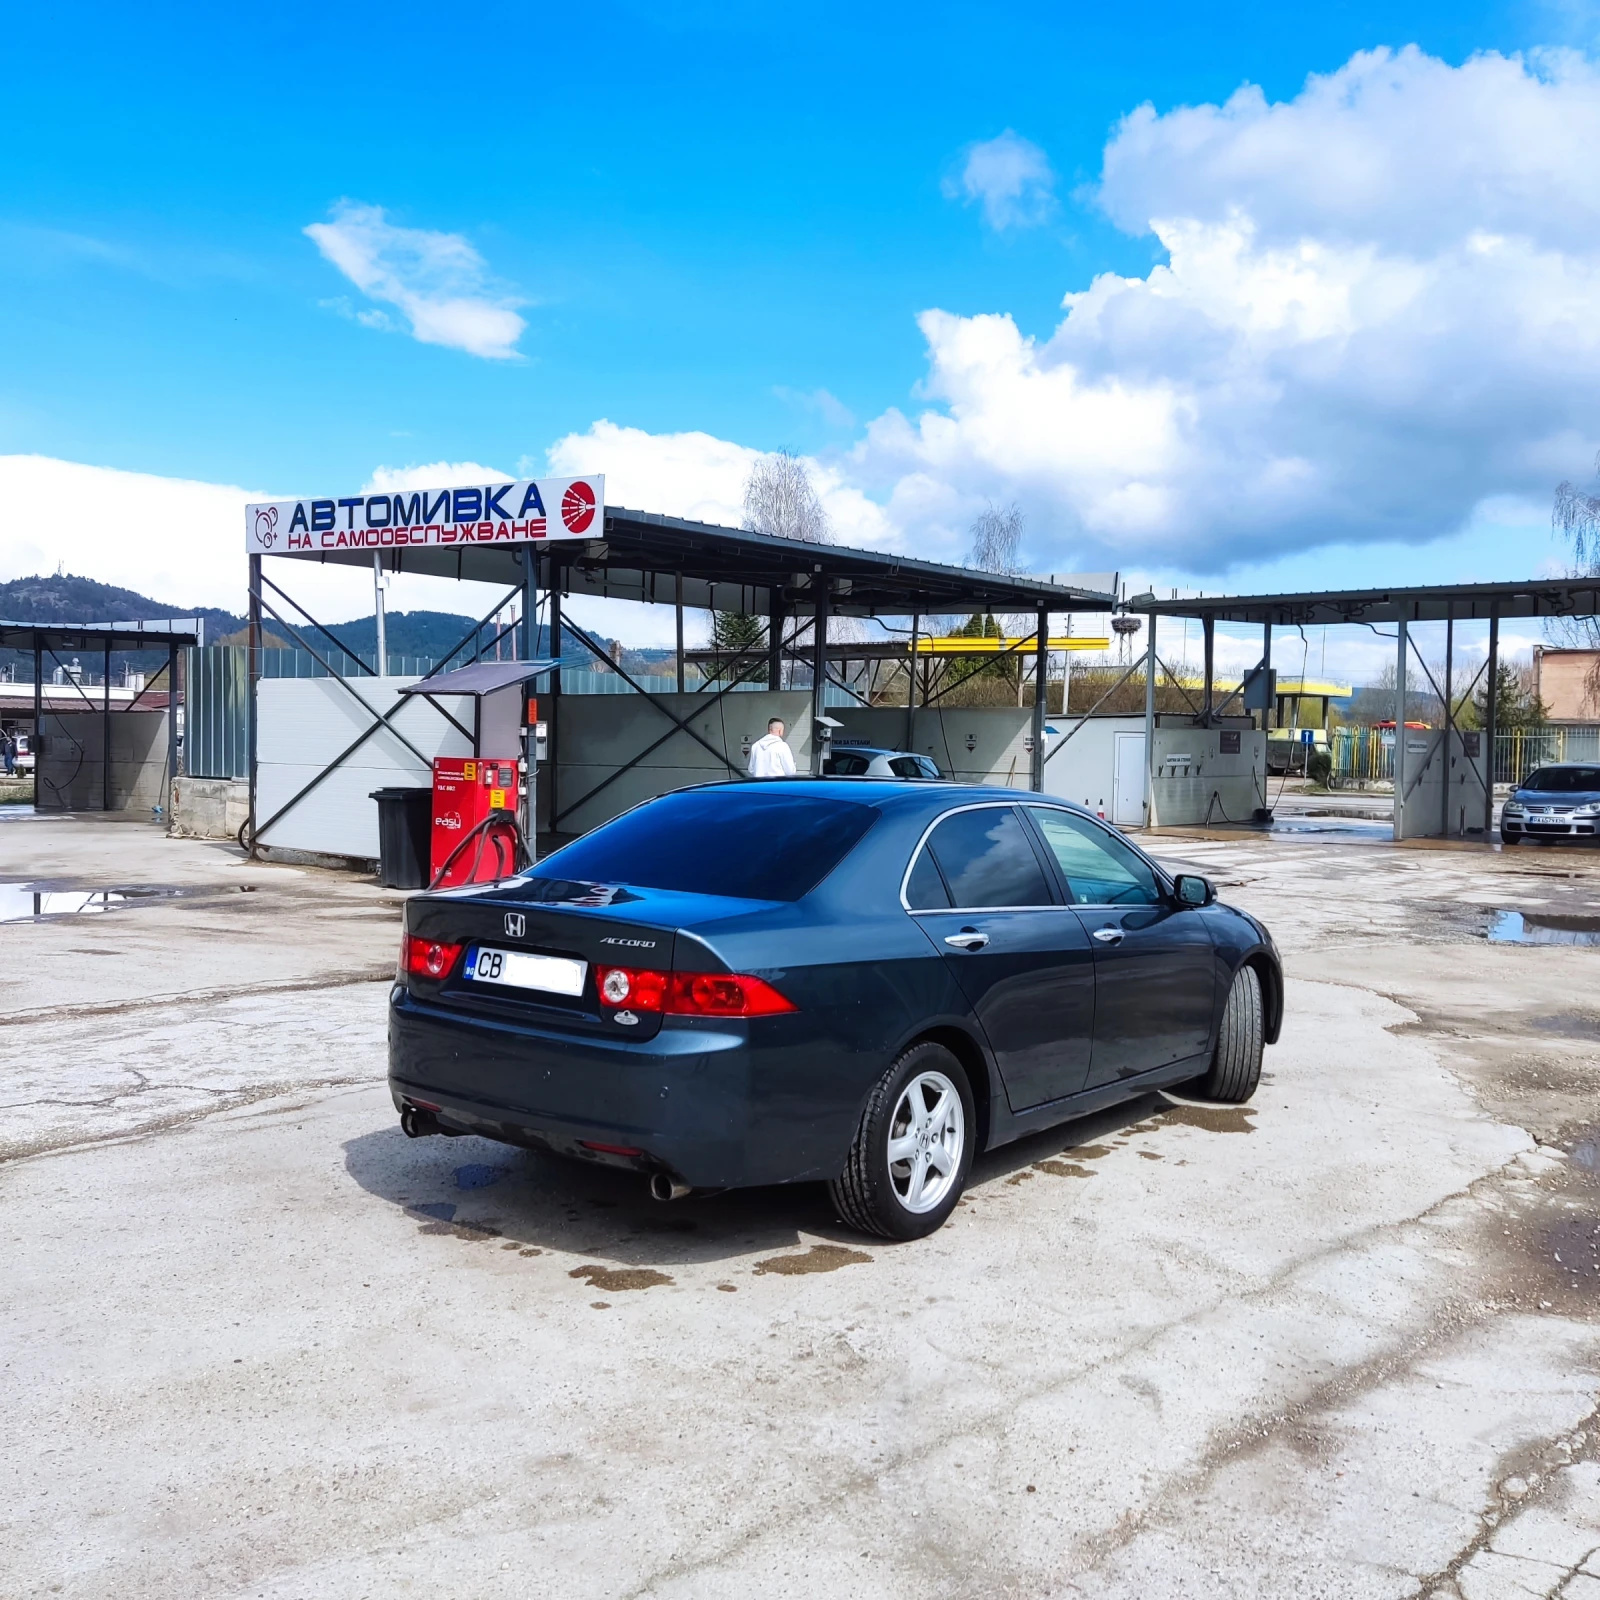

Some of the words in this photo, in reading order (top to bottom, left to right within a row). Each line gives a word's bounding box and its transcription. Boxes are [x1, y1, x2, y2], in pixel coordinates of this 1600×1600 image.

[288, 482, 547, 533] АВТОМИВКА
[288, 532, 312, 549] НА
[321, 518, 547, 548] САМООБСЛУЖВАНЕ
[435, 817, 461, 829] easy
[600, 937, 656, 948] ACCORD
[478, 952, 503, 979] CB
